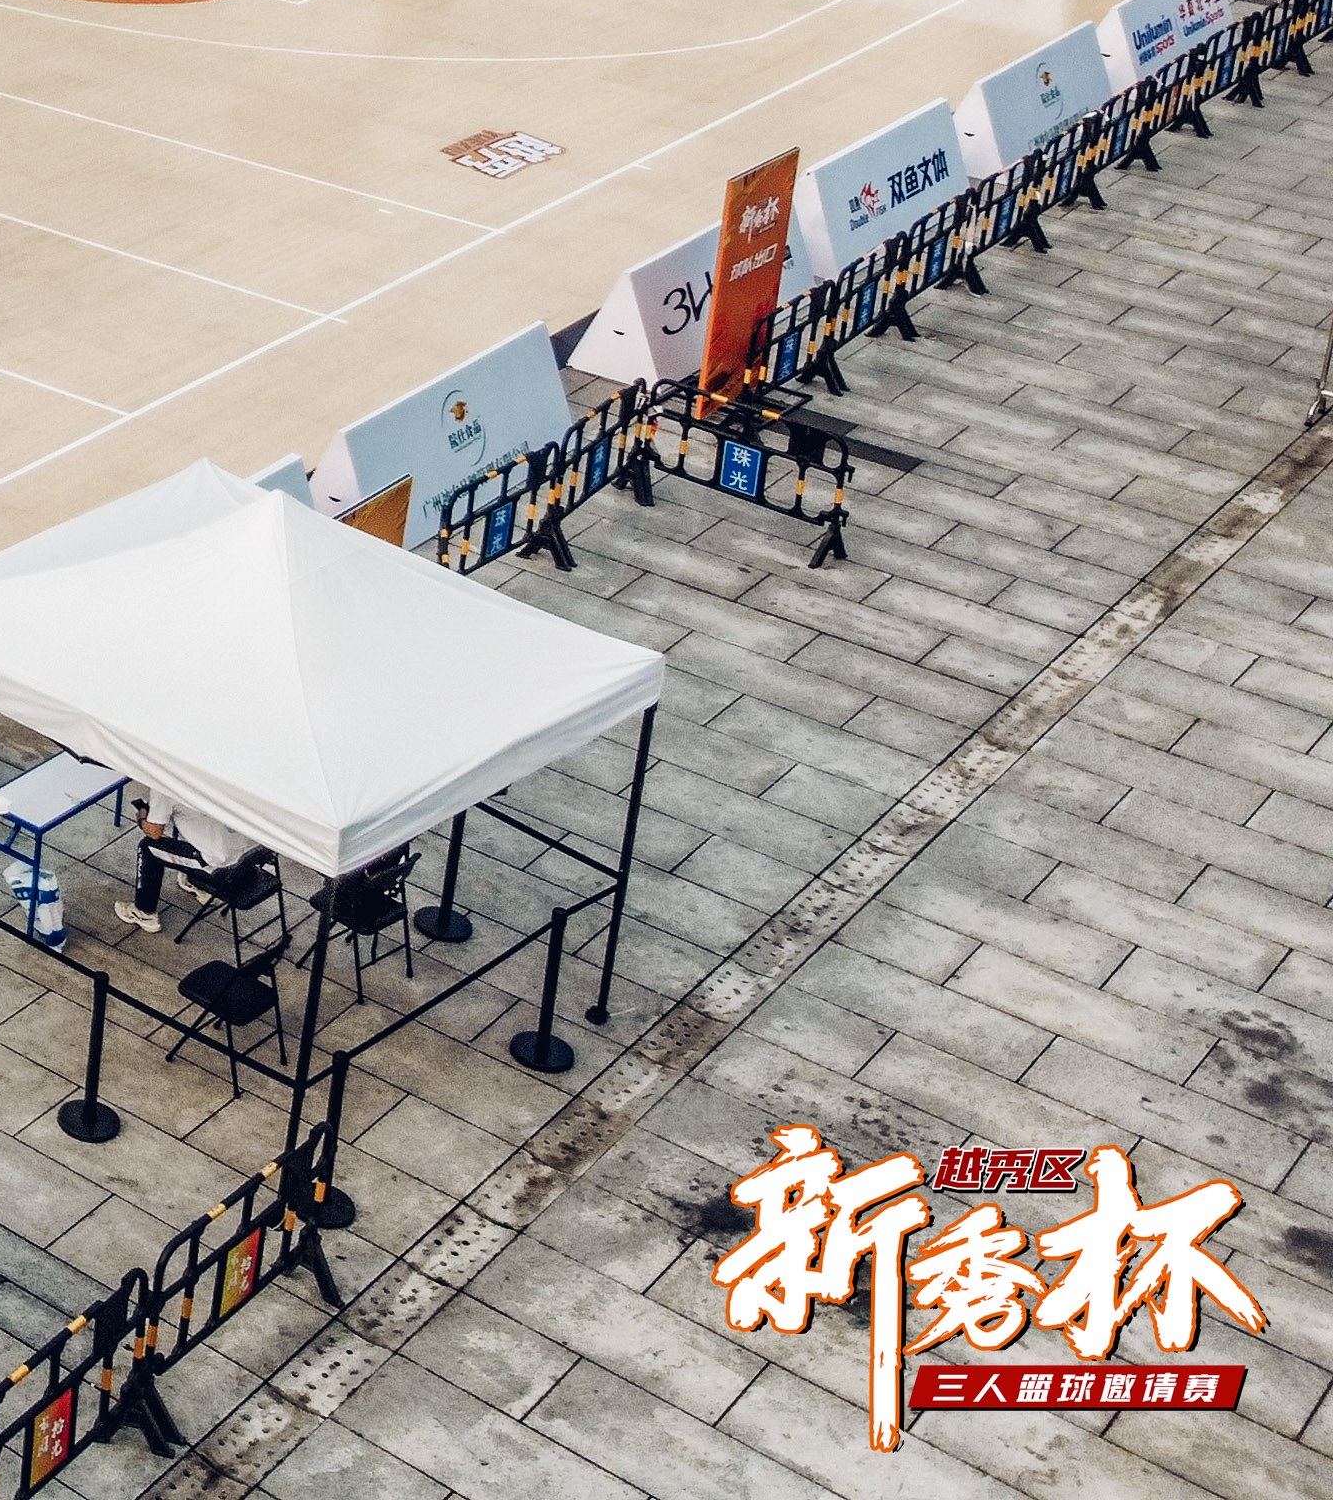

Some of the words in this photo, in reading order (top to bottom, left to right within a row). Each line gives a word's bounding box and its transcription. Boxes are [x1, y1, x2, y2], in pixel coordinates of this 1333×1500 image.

[1132, 14, 1173, 50] Unilumin
[887, 148, 949, 208] 双鱼文体
[729, 243, 778, 282] 球队出口
[447, 418, 482, 452] 院仕食品
[730, 446, 750, 491] 珠光
[490, 508, 507, 557] 珠光
